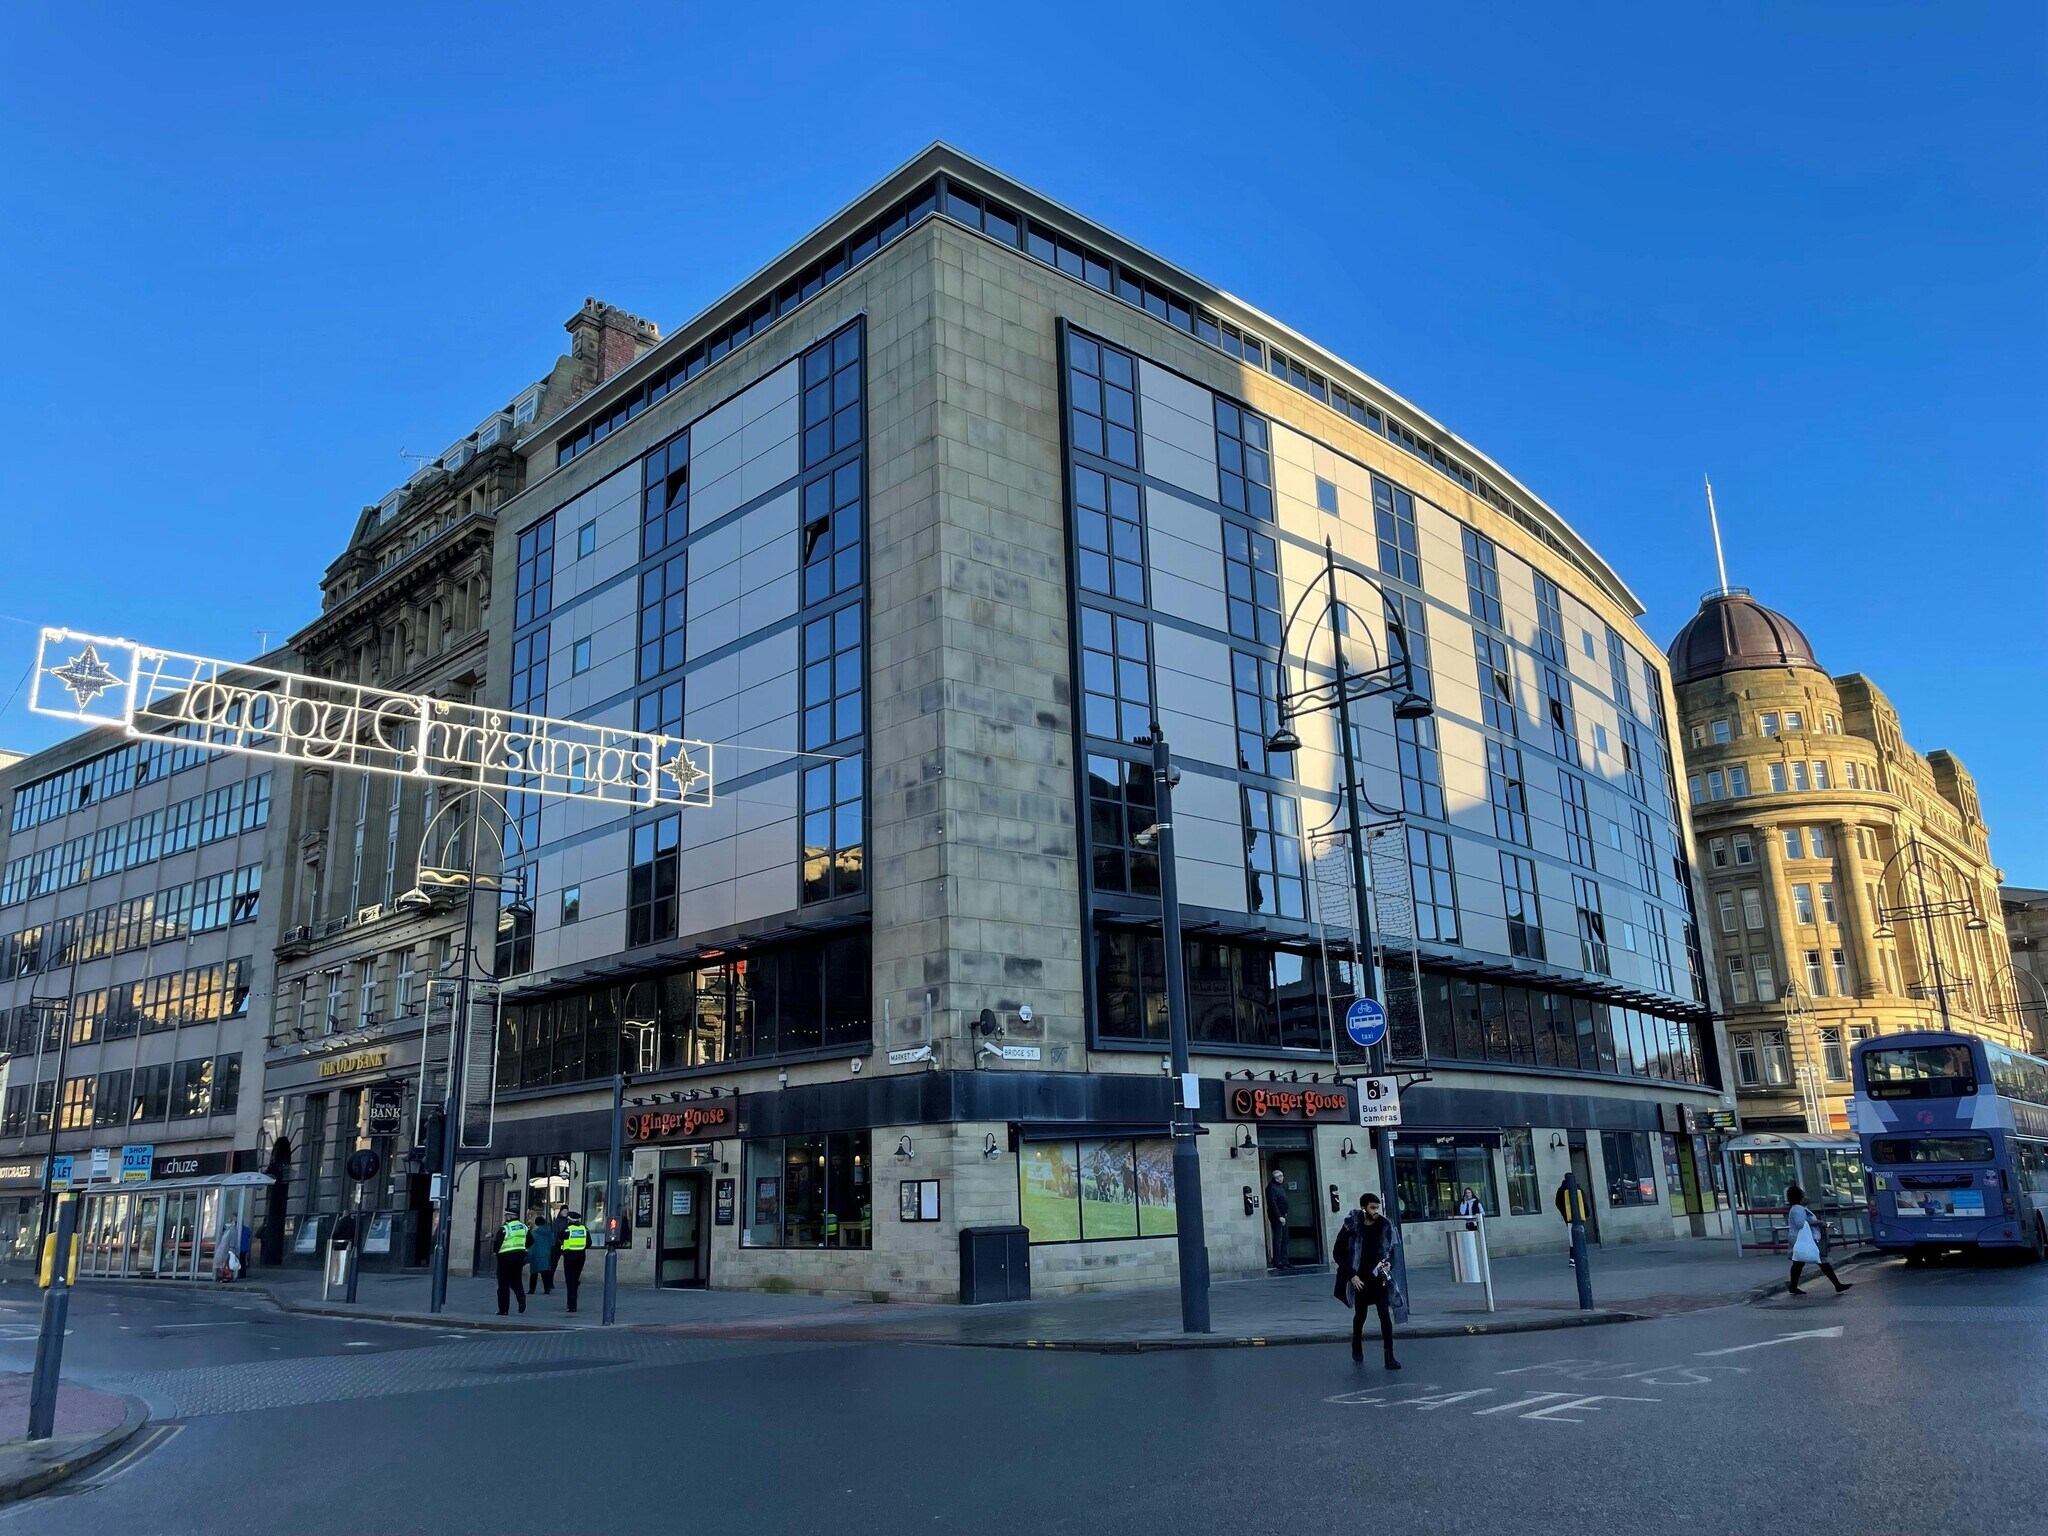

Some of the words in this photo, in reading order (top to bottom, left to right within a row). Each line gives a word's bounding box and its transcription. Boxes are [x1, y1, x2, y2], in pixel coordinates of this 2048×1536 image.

[144, 653, 353, 760] Happy
[374, 698, 653, 789] Christmas
[1004, 1049, 1025, 1057] BRIDGE
[319, 1061, 337, 1076] THE
[337, 1057, 356, 1073] OLD
[357, 1053, 385, 1069] BANK
[1254, 1089, 1303, 1117] ginger
[1304, 1090, 1347, 1117] goose
[1362, 1105, 1378, 1113] Bus
[1379, 1104, 1397, 1112] lane
[370, 1108, 401, 1118] BANK
[1363, 1115, 1398, 1123] cameras
[640, 1113, 683, 1140] ginger
[683, 1108, 725, 1135] goose
[123, 1155, 134, 1166] TO
[136, 1154, 152, 1165] LET
[57, 1166, 72, 1178] LET
[1324, 1383, 1662, 1423] GATE
